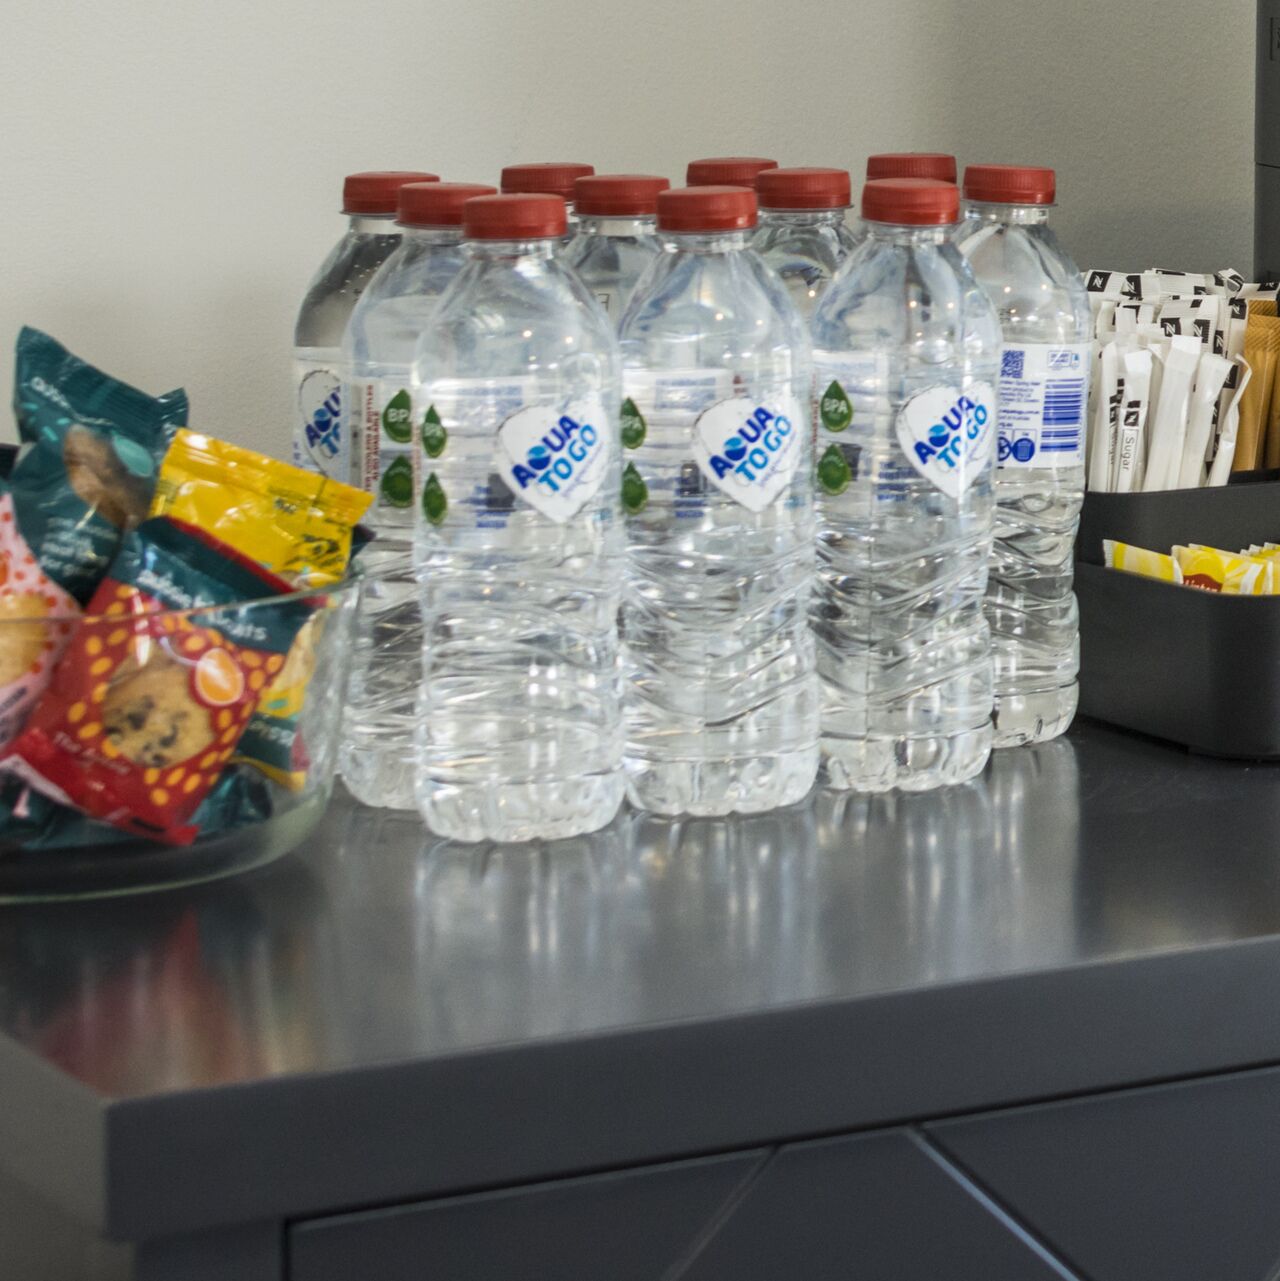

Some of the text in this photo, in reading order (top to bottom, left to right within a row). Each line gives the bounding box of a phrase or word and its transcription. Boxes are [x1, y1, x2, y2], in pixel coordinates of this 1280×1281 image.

[305, 386, 341, 449] AQU
[387, 408, 409, 422] BP
[823, 397, 849, 415] BPA
[913, 396, 976, 465] AQUA
[966, 404, 988, 440] GO
[511, 415, 581, 489] AQUA
[538, 424, 597, 494] TO GO
[709, 407, 775, 480] AQUA
[735, 415, 792, 482] TO GO
[1121, 436, 1135, 471] Sugar
